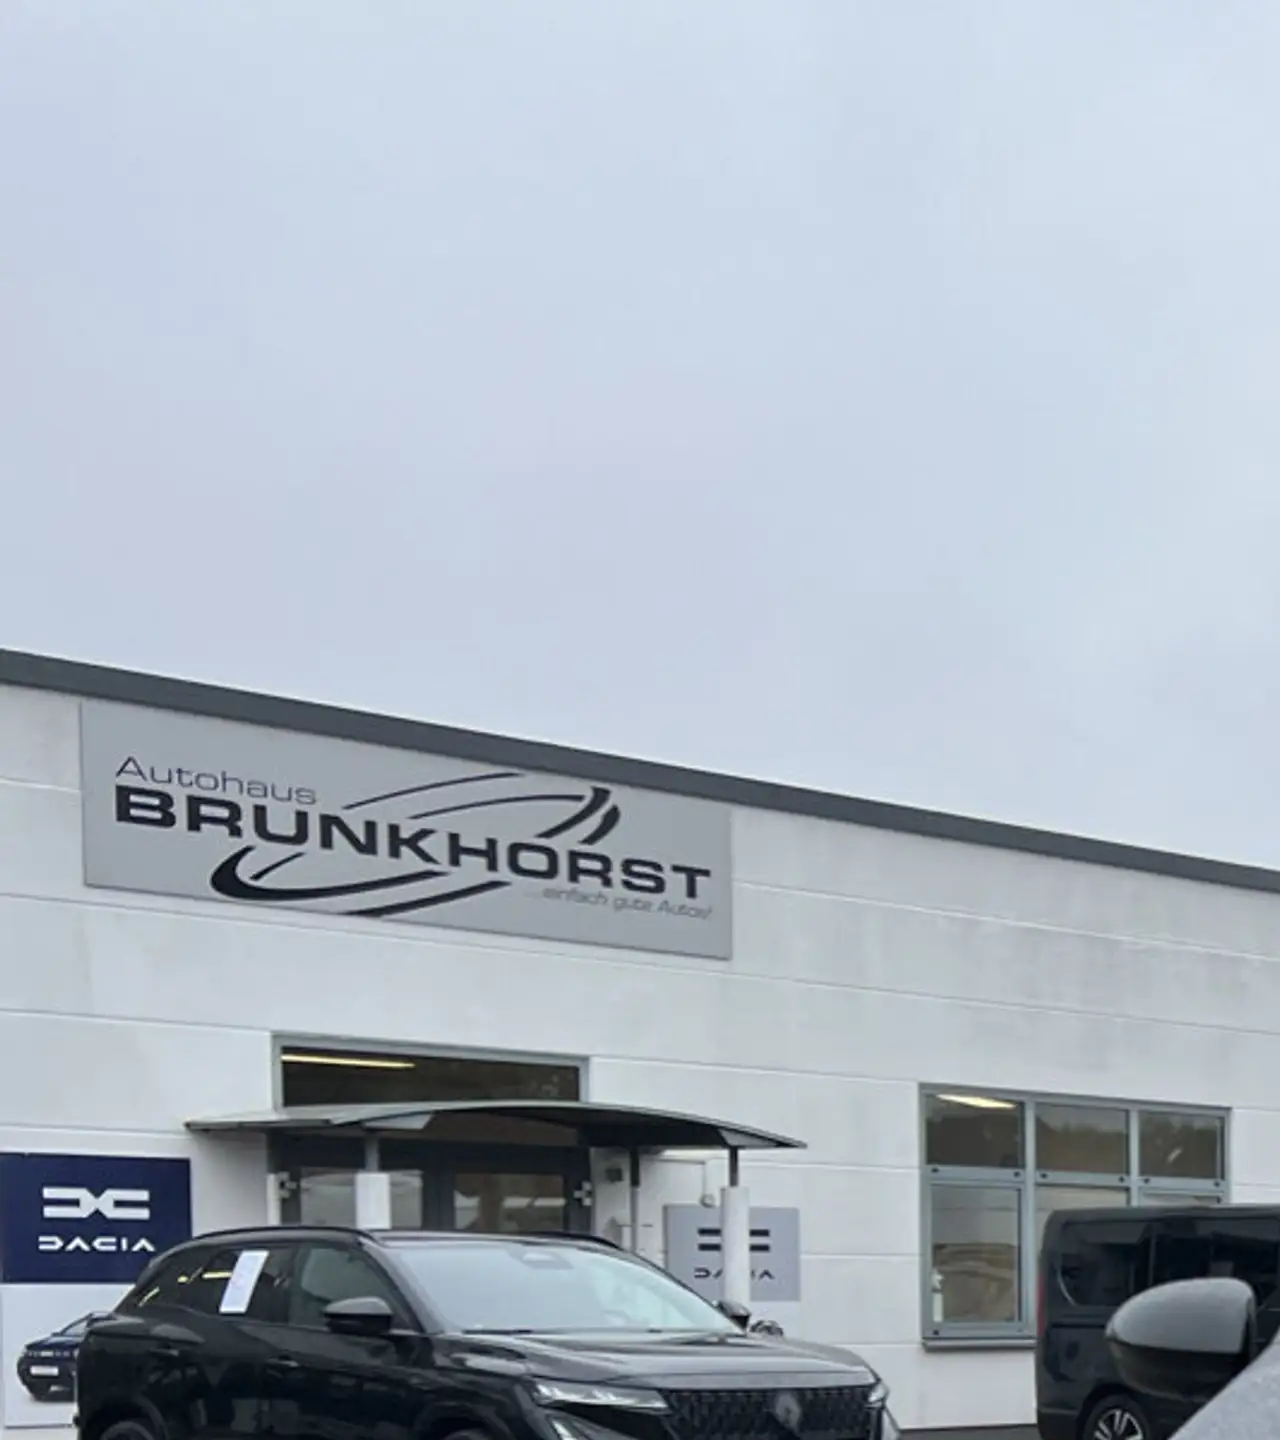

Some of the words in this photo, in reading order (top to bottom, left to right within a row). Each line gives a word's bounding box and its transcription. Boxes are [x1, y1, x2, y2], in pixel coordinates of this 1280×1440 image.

[115, 756, 317, 805] Autohaus
[115, 784, 712, 899] BRUNKHORST
[38, 1235, 156, 1252] DACIA
